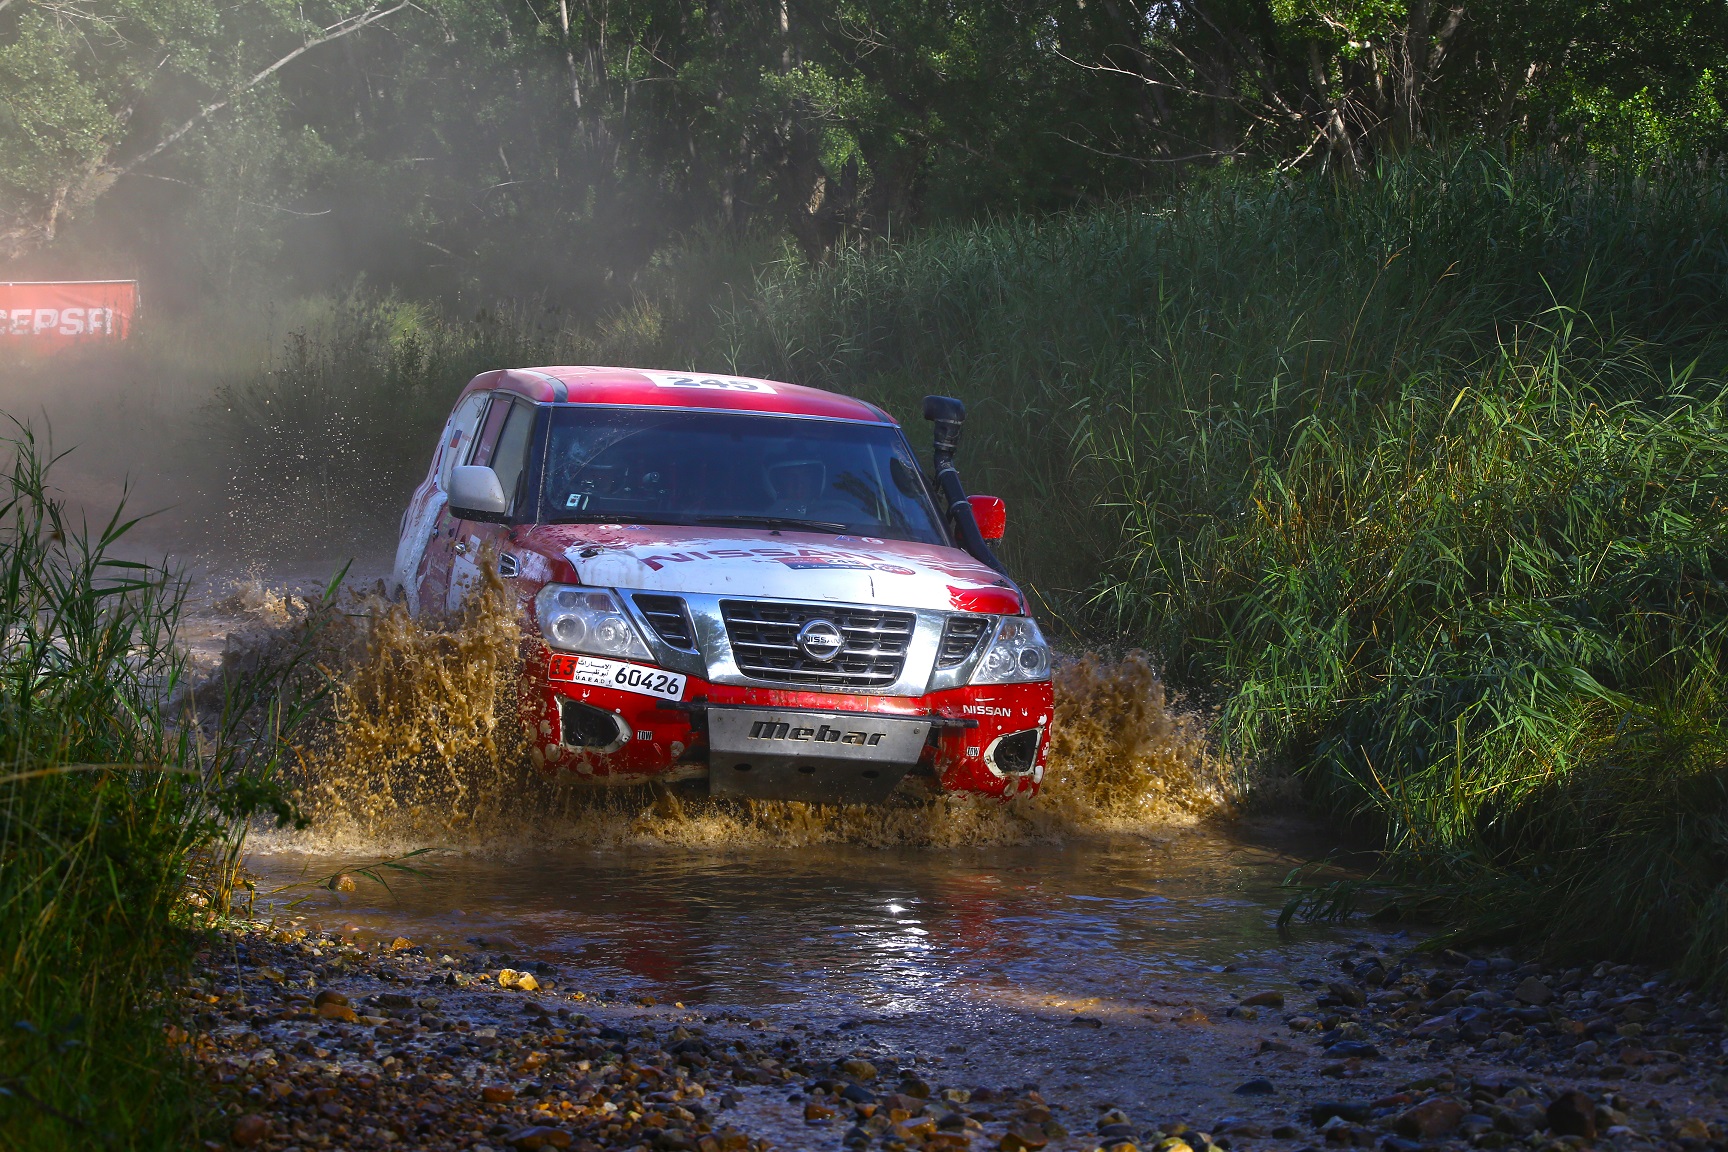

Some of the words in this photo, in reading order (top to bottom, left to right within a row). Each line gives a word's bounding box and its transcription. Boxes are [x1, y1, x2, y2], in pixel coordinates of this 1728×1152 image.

[0, 307, 113, 335] EPSA
[640, 548, 885, 571] NISSAN
[802, 634, 840, 645] NISSAN
[614, 666, 679, 695] 60426
[962, 704, 1012, 718] NISSAN
